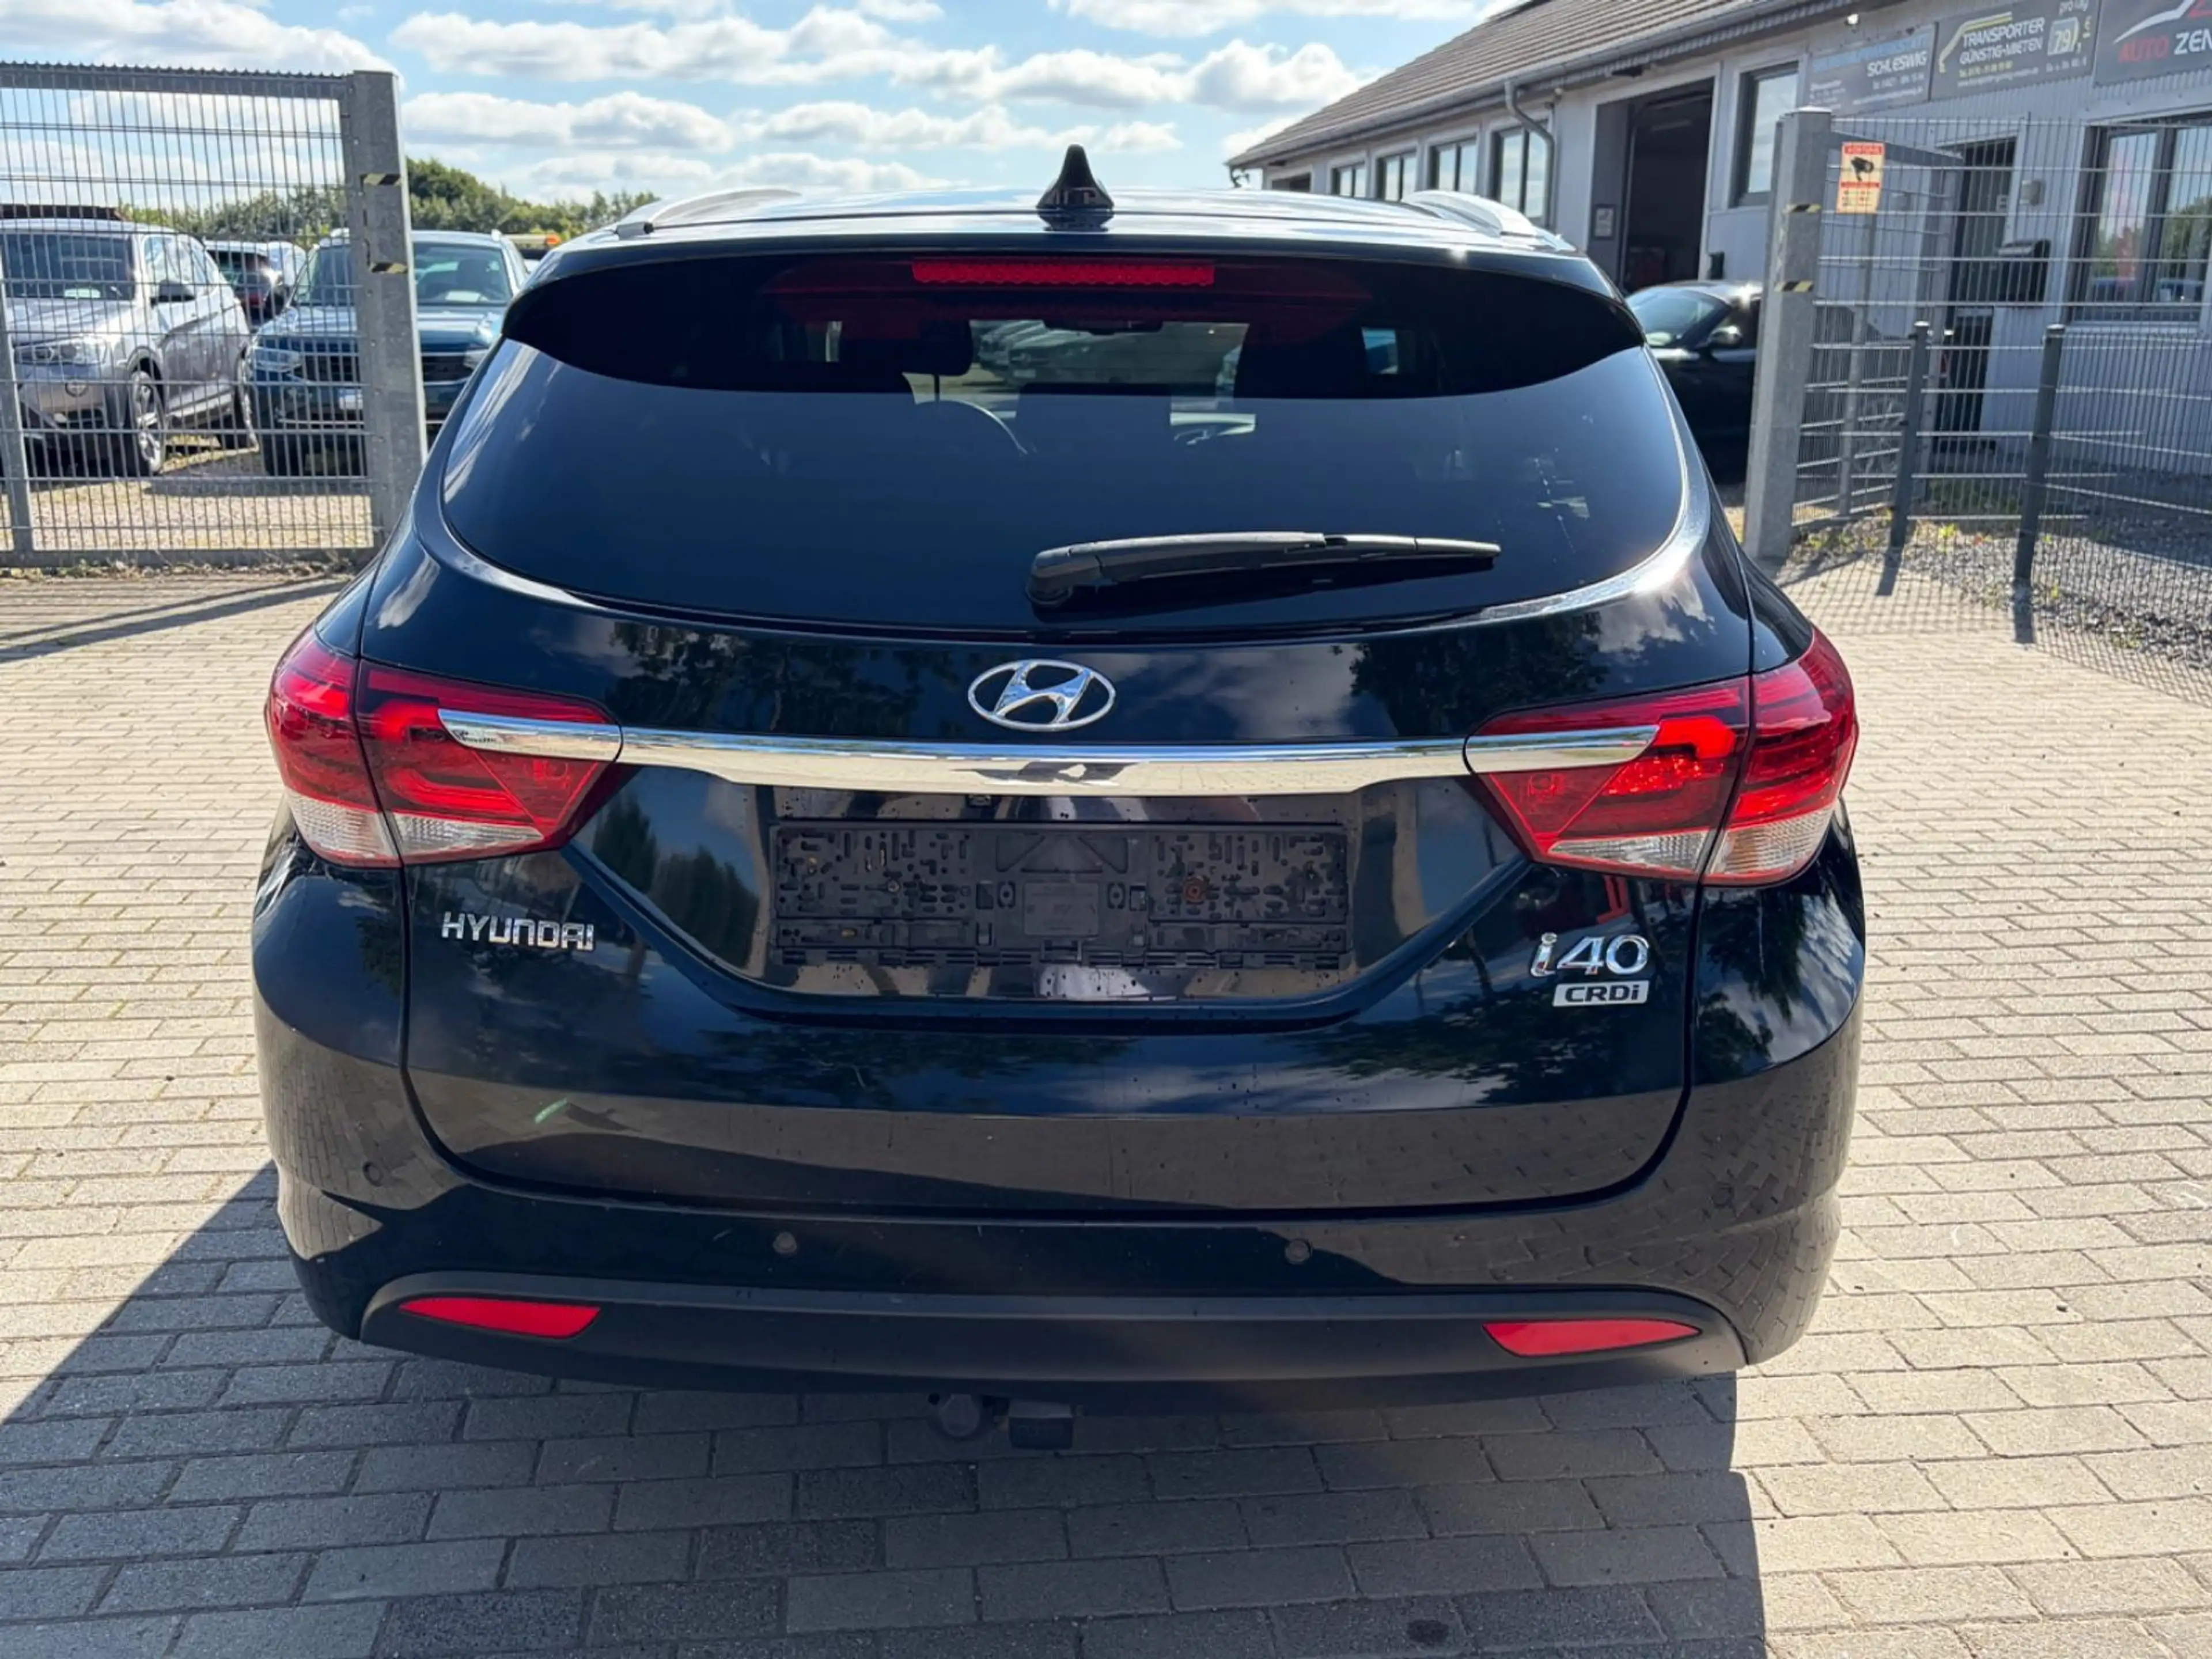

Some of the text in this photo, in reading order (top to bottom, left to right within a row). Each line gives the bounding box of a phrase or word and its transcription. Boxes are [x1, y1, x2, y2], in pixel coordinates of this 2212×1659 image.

[1963, 17, 2046, 48] TRANSPORTER
[2119, 35, 2169, 63] AUTO
[1867, 50, 1927, 78] SCHLESWIG
[441, 911, 594, 951] HYUNDAI
[1530, 932, 1650, 977] i40
[1565, 984, 1641, 1003] CRDi
